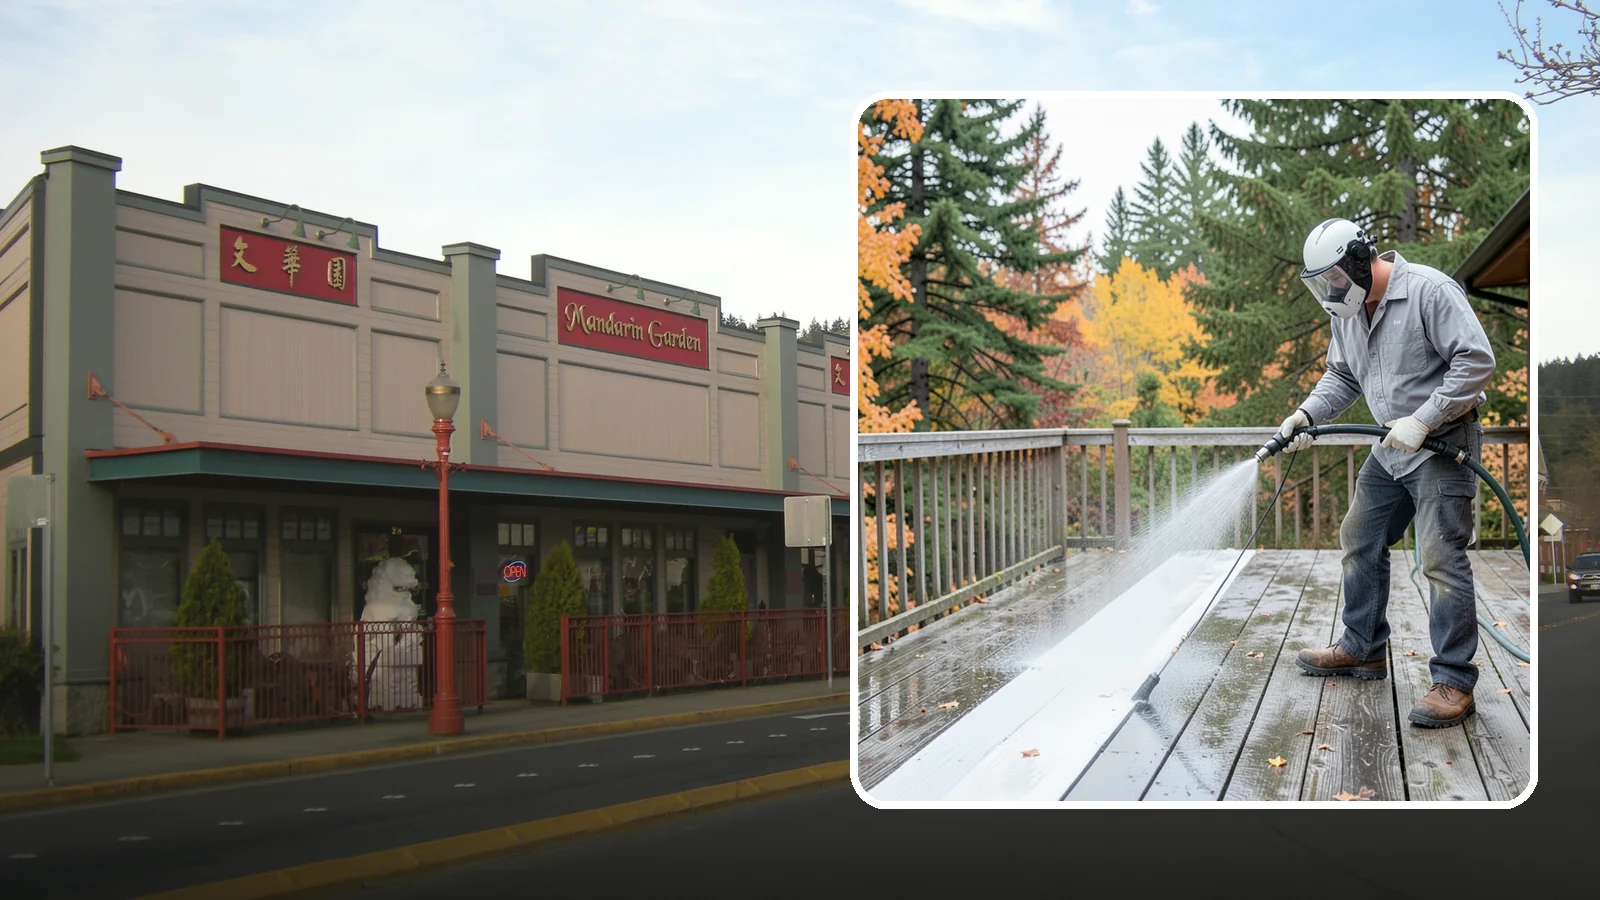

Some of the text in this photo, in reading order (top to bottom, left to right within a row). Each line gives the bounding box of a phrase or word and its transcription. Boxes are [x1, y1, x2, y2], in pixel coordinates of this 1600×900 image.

[231, 235, 346, 290] 文華園
[564, 302, 702, 352] Mandarin Garden
[503, 565, 526, 578] OPEN
